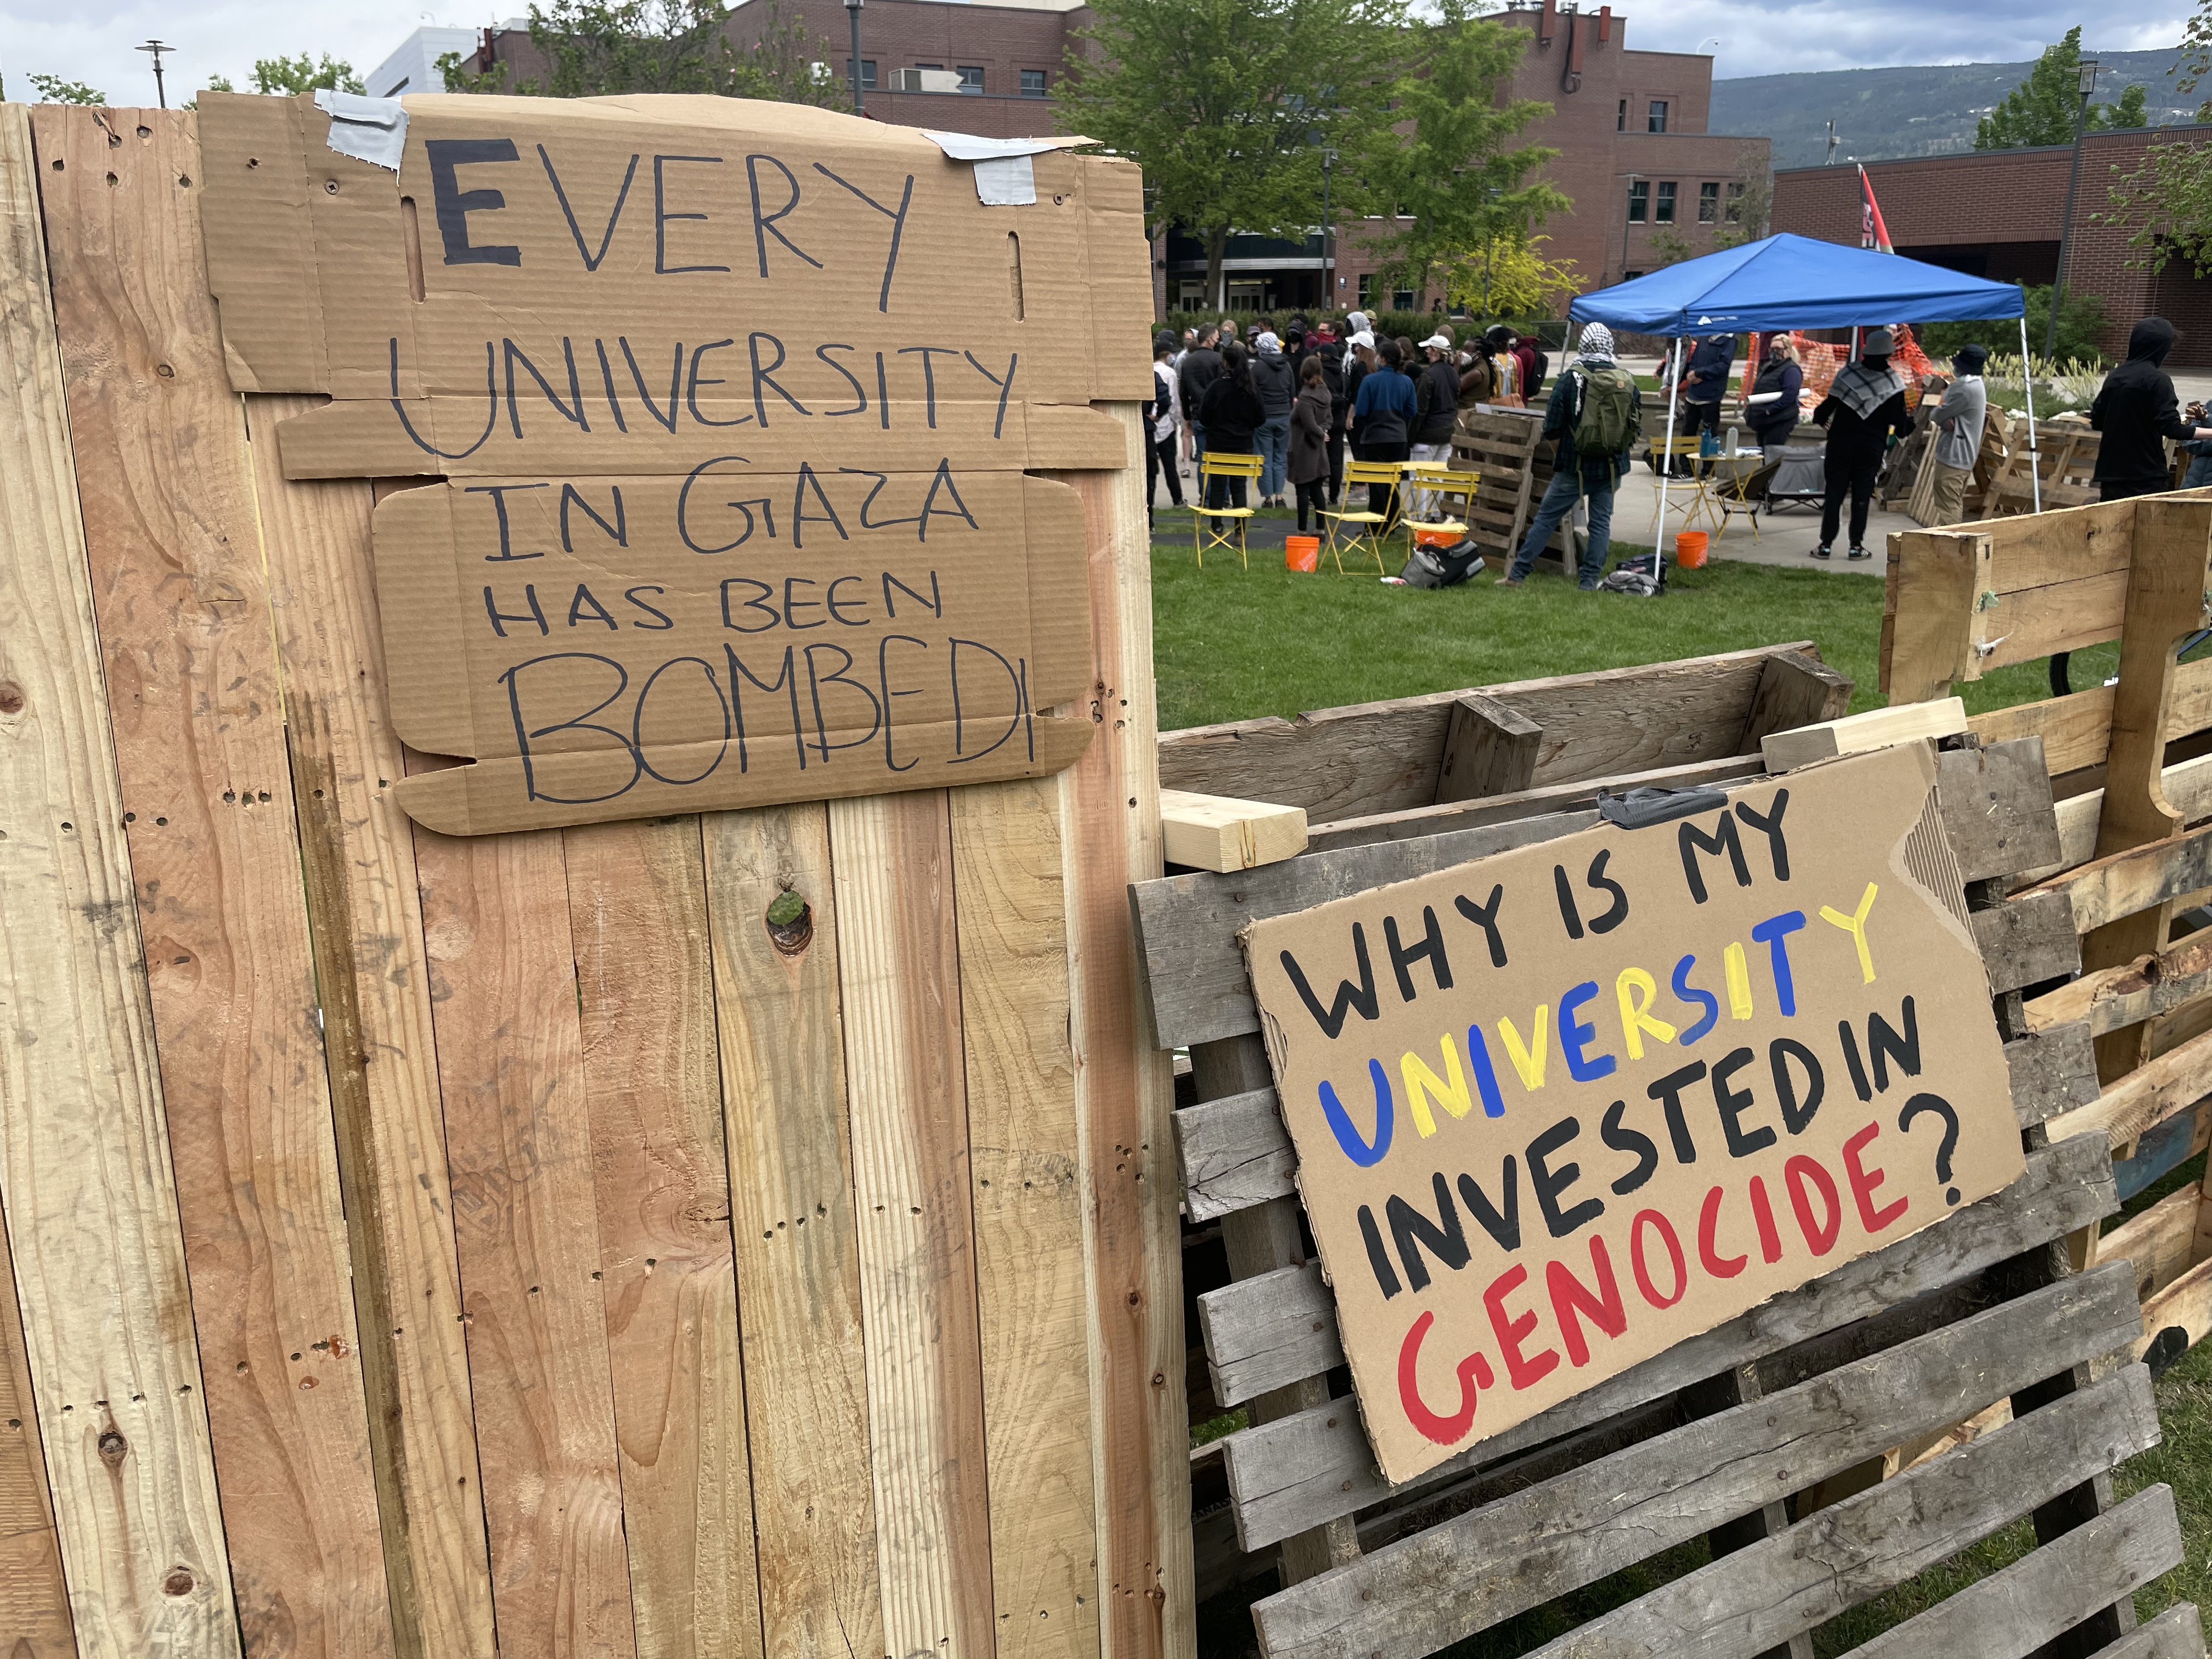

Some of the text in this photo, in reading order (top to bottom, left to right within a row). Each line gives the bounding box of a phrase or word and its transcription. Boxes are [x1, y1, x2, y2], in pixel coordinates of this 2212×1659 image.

[424, 138, 914, 313] EVERY
[390, 331, 1018, 459] UNIVERSITY
[465, 456, 979, 562] IN GAZA
[483, 571, 941, 637] HAS BEEN
[497, 635, 1035, 805] BOMBED!
[1279, 788, 1790, 1039] WHY IS MY
[1318, 882, 1878, 1167] UNIVERSITY
[1357, 995, 1921, 1301] INVESTED IN
